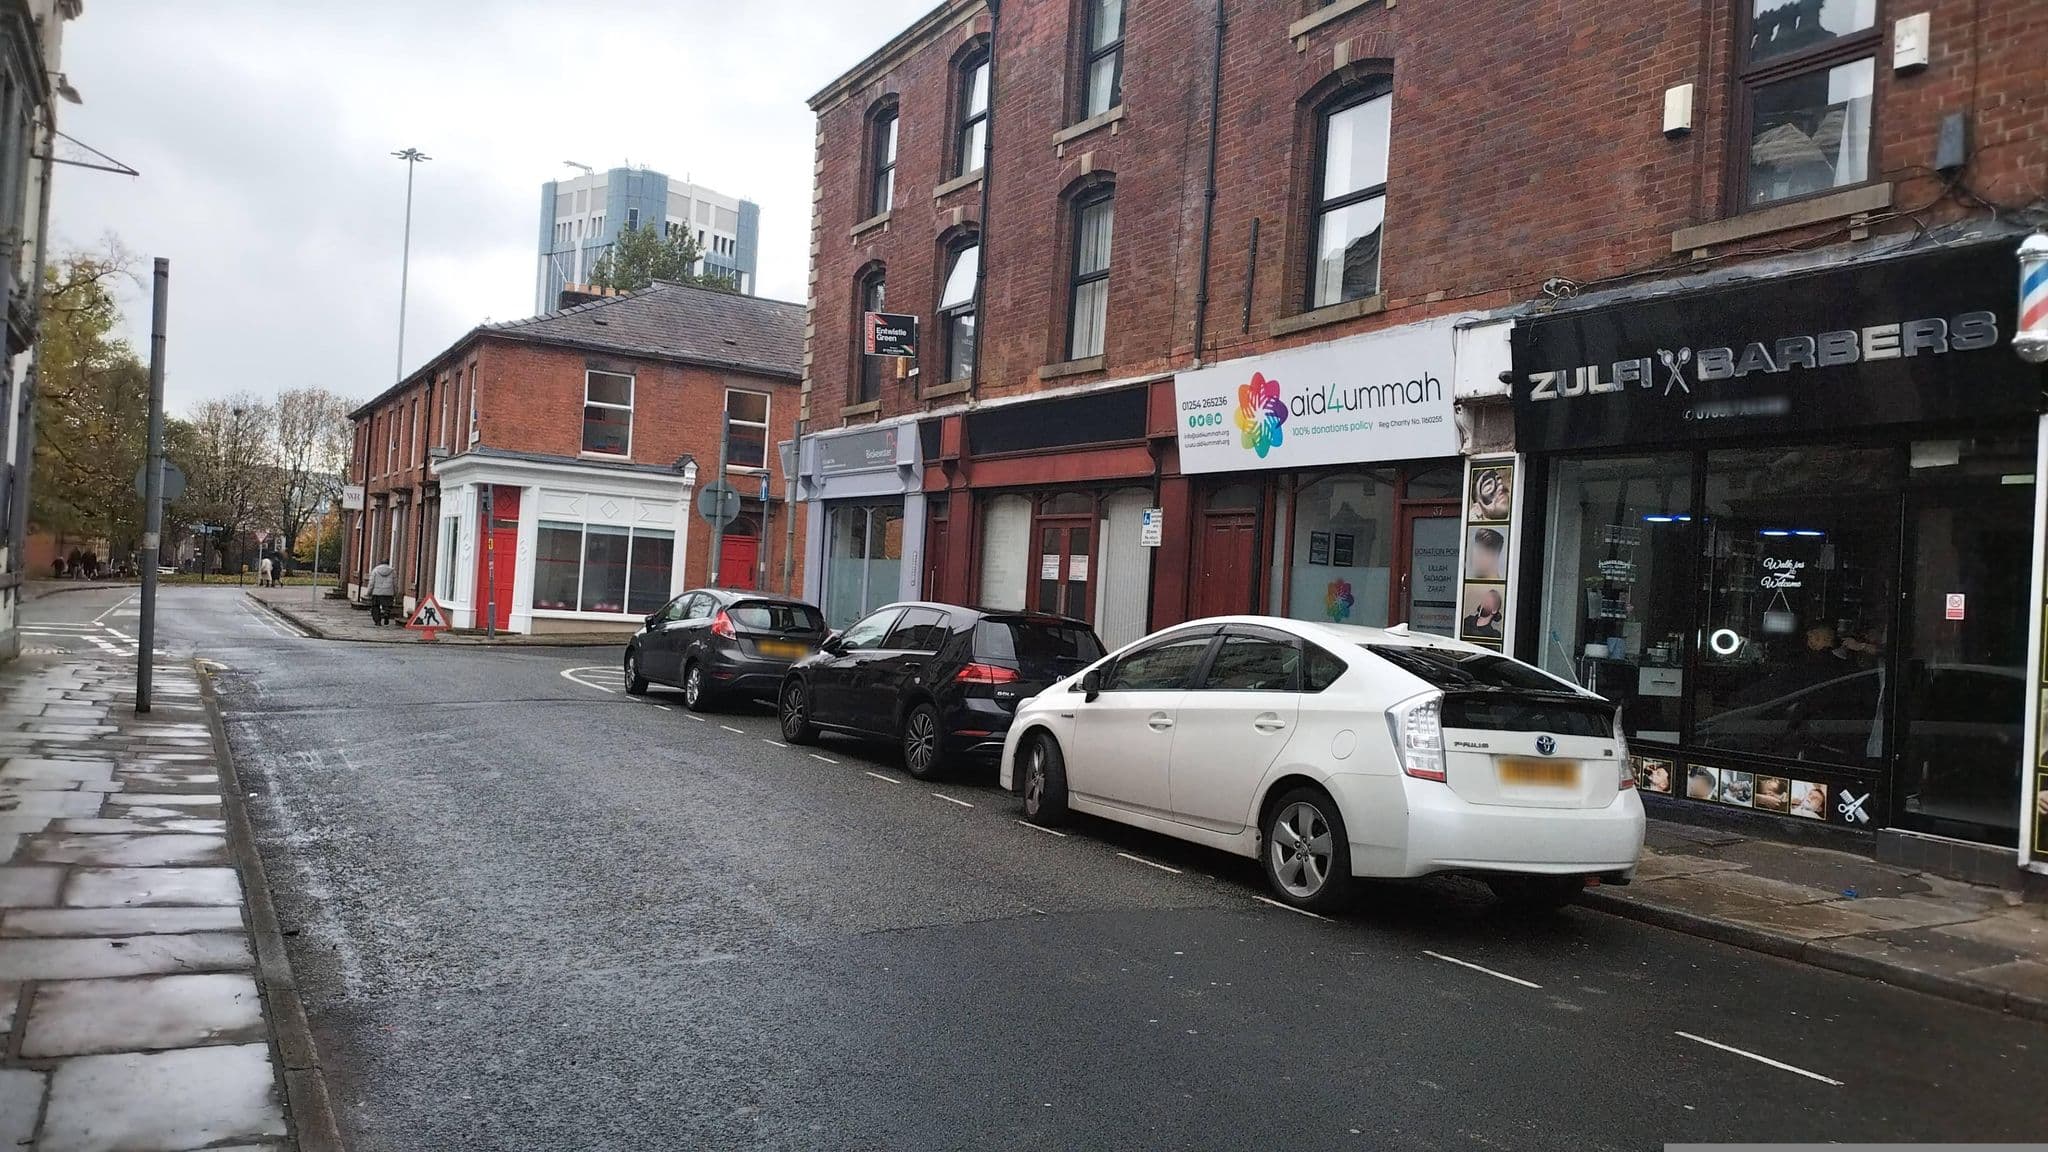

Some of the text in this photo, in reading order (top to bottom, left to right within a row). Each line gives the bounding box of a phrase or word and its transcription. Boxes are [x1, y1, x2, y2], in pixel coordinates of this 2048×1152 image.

[876, 327, 907, 336] Entwistle
[876, 334, 897, 342] Green
[1528, 310, 1998, 402] ZULFI BARBERS
[1290, 371, 1442, 417] aid4ummah
[1182, 396, 1228, 411] 01254 265236
[1292, 420, 1373, 436] 100% donations policy
[1390, 418, 1410, 428] Charity
[1763, 557, 1793, 570] Walk
[1760, 575, 1802, 588] Welcome
